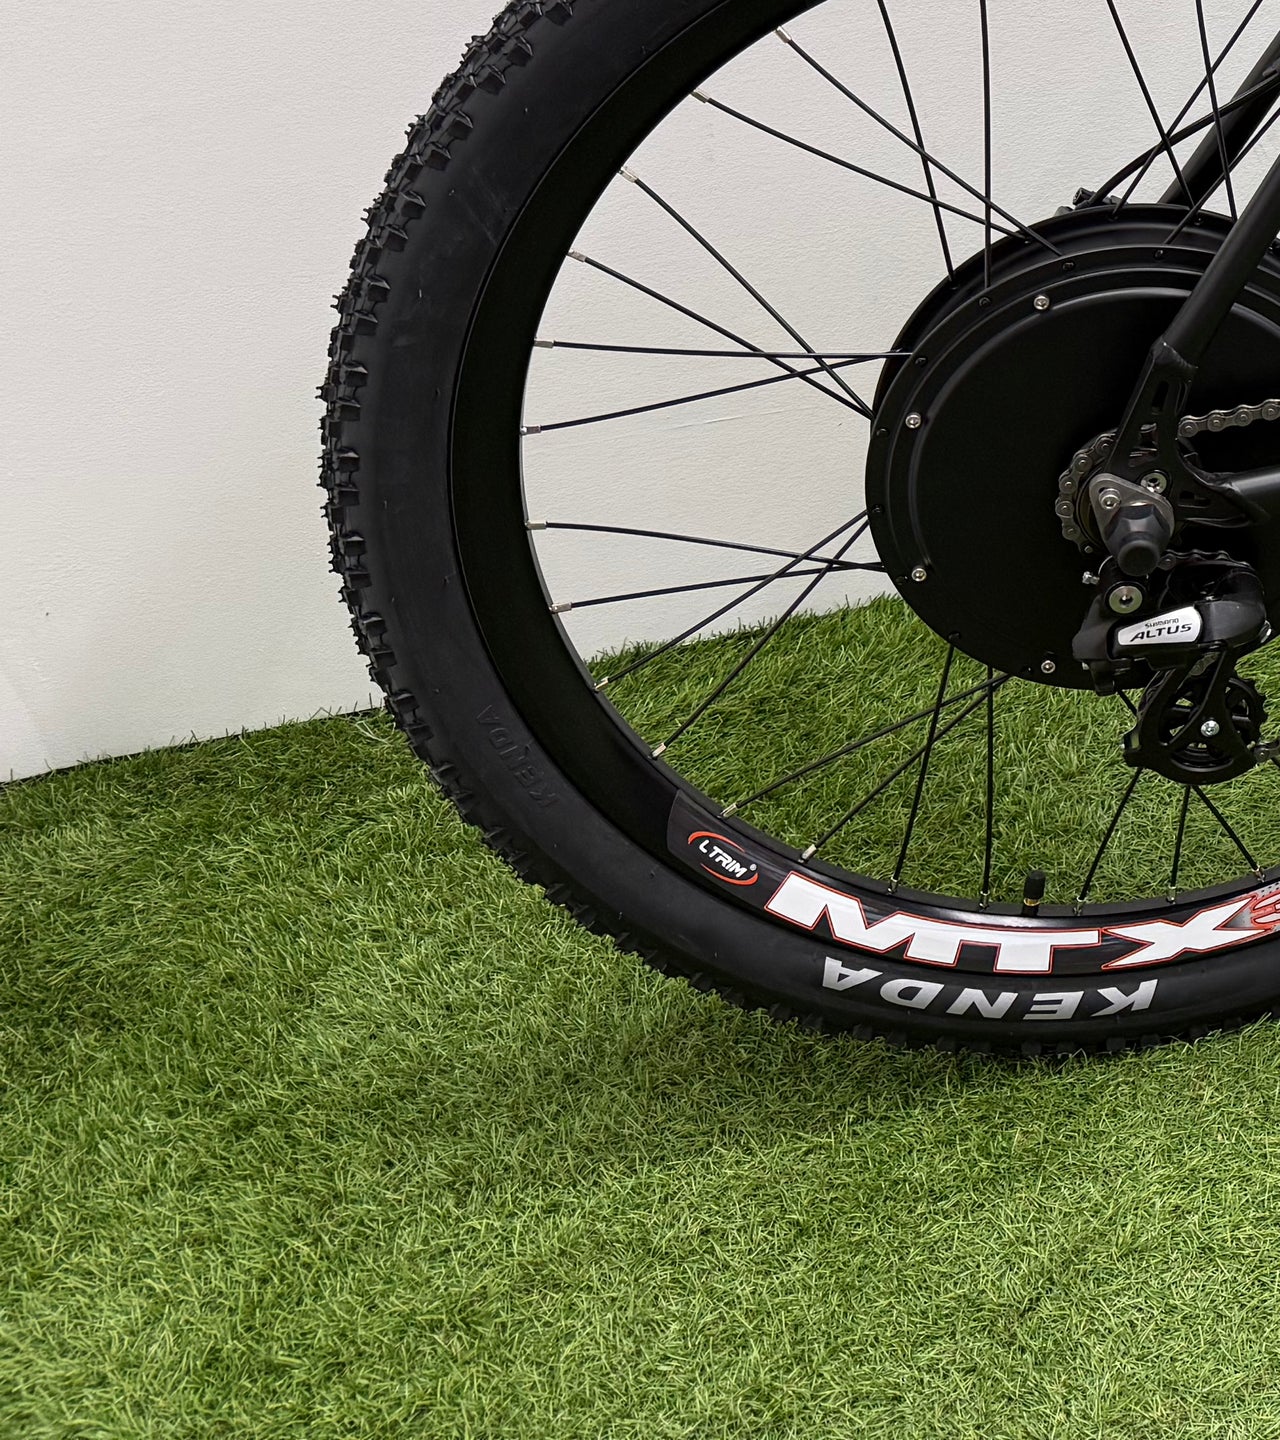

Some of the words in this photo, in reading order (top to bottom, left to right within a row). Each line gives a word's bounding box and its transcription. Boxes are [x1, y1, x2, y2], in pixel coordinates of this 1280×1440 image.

[1129, 623, 1193, 642] ALTUS
[475, 701, 558, 810] KENDA
[821, 955, 1158, 1020] KENDA
